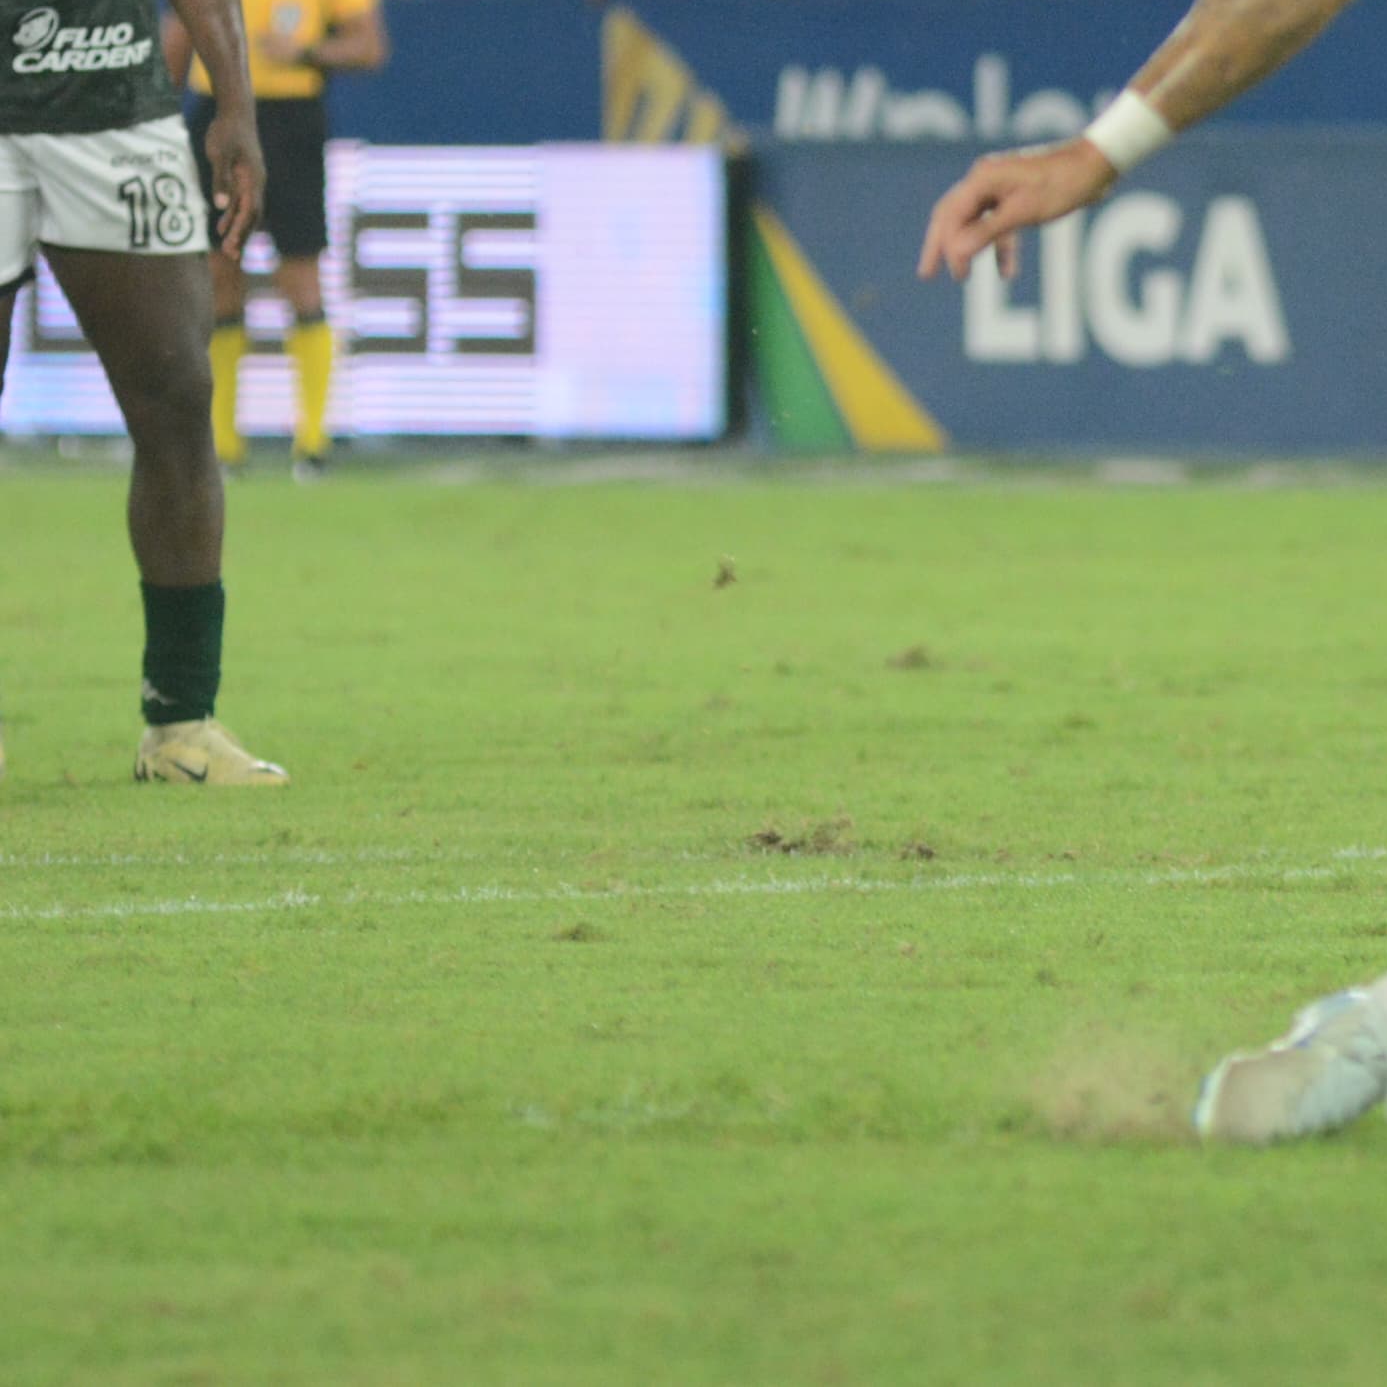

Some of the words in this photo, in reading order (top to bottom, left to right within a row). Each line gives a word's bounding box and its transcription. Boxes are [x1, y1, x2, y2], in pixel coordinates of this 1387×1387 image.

[52, 22, 133, 50] FLUO
[118, 174, 195, 249] 18
[963, 191, 1291, 366] LIGA
